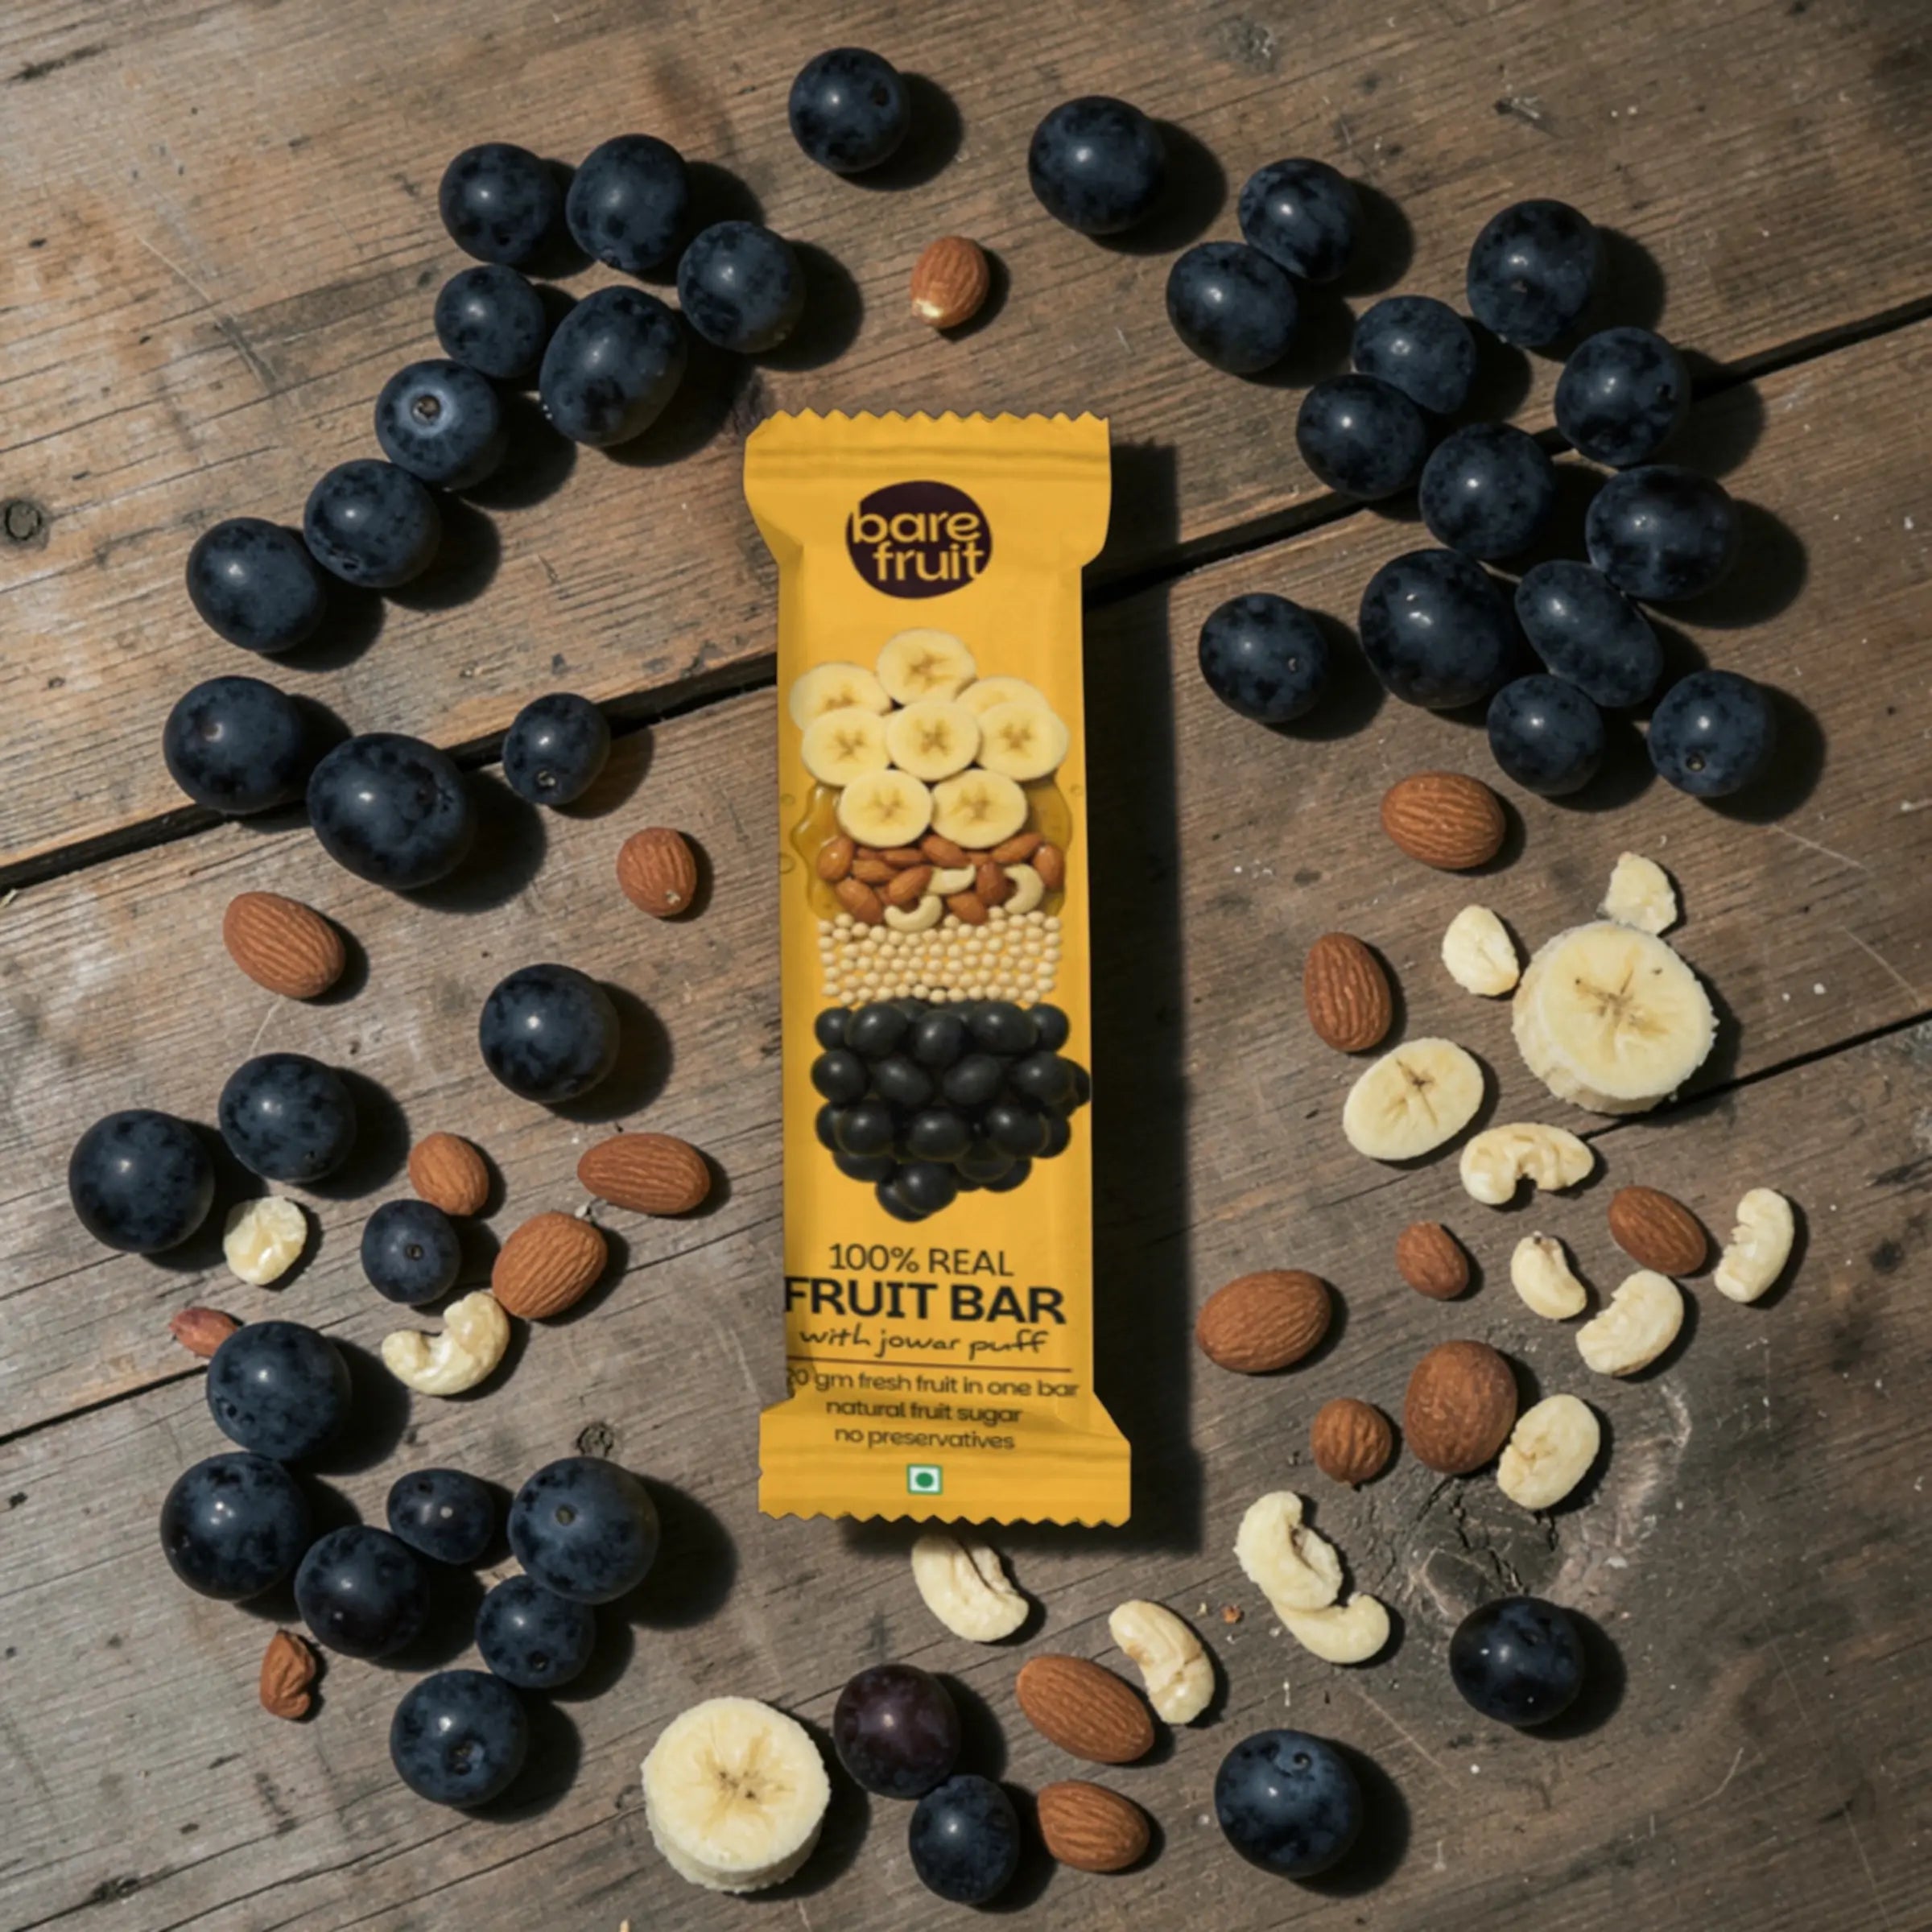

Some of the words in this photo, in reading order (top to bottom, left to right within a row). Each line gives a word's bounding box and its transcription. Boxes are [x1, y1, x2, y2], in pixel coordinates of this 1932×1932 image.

[851, 499, 982, 543] bare
[872, 540, 985, 581] fruit
[829, 1244, 919, 1274] 100%
[928, 1249, 1014, 1276] REAL
[784, 1276, 938, 1319] FRUIT
[950, 1285, 1067, 1324] BAR
[799, 1323, 871, 1348] with
[873, 1330, 960, 1358] jowar
[968, 1330, 1050, 1360] puff
[815, 1373, 853, 1393] gm
[858, 1373, 912, 1393] fresh
[915, 1375, 958, 1394] fruit
[963, 1377, 983, 1394] in
[987, 1381, 1031, 1396] one
[1038, 1380, 1079, 1397] bar
[826, 1400, 906, 1418] natural
[910, 1403, 952, 1420] fruit
[956, 1407, 1022, 1427] sugar
[835, 1427, 865, 1443] no
[868, 1429, 1016, 1450] preservatives
